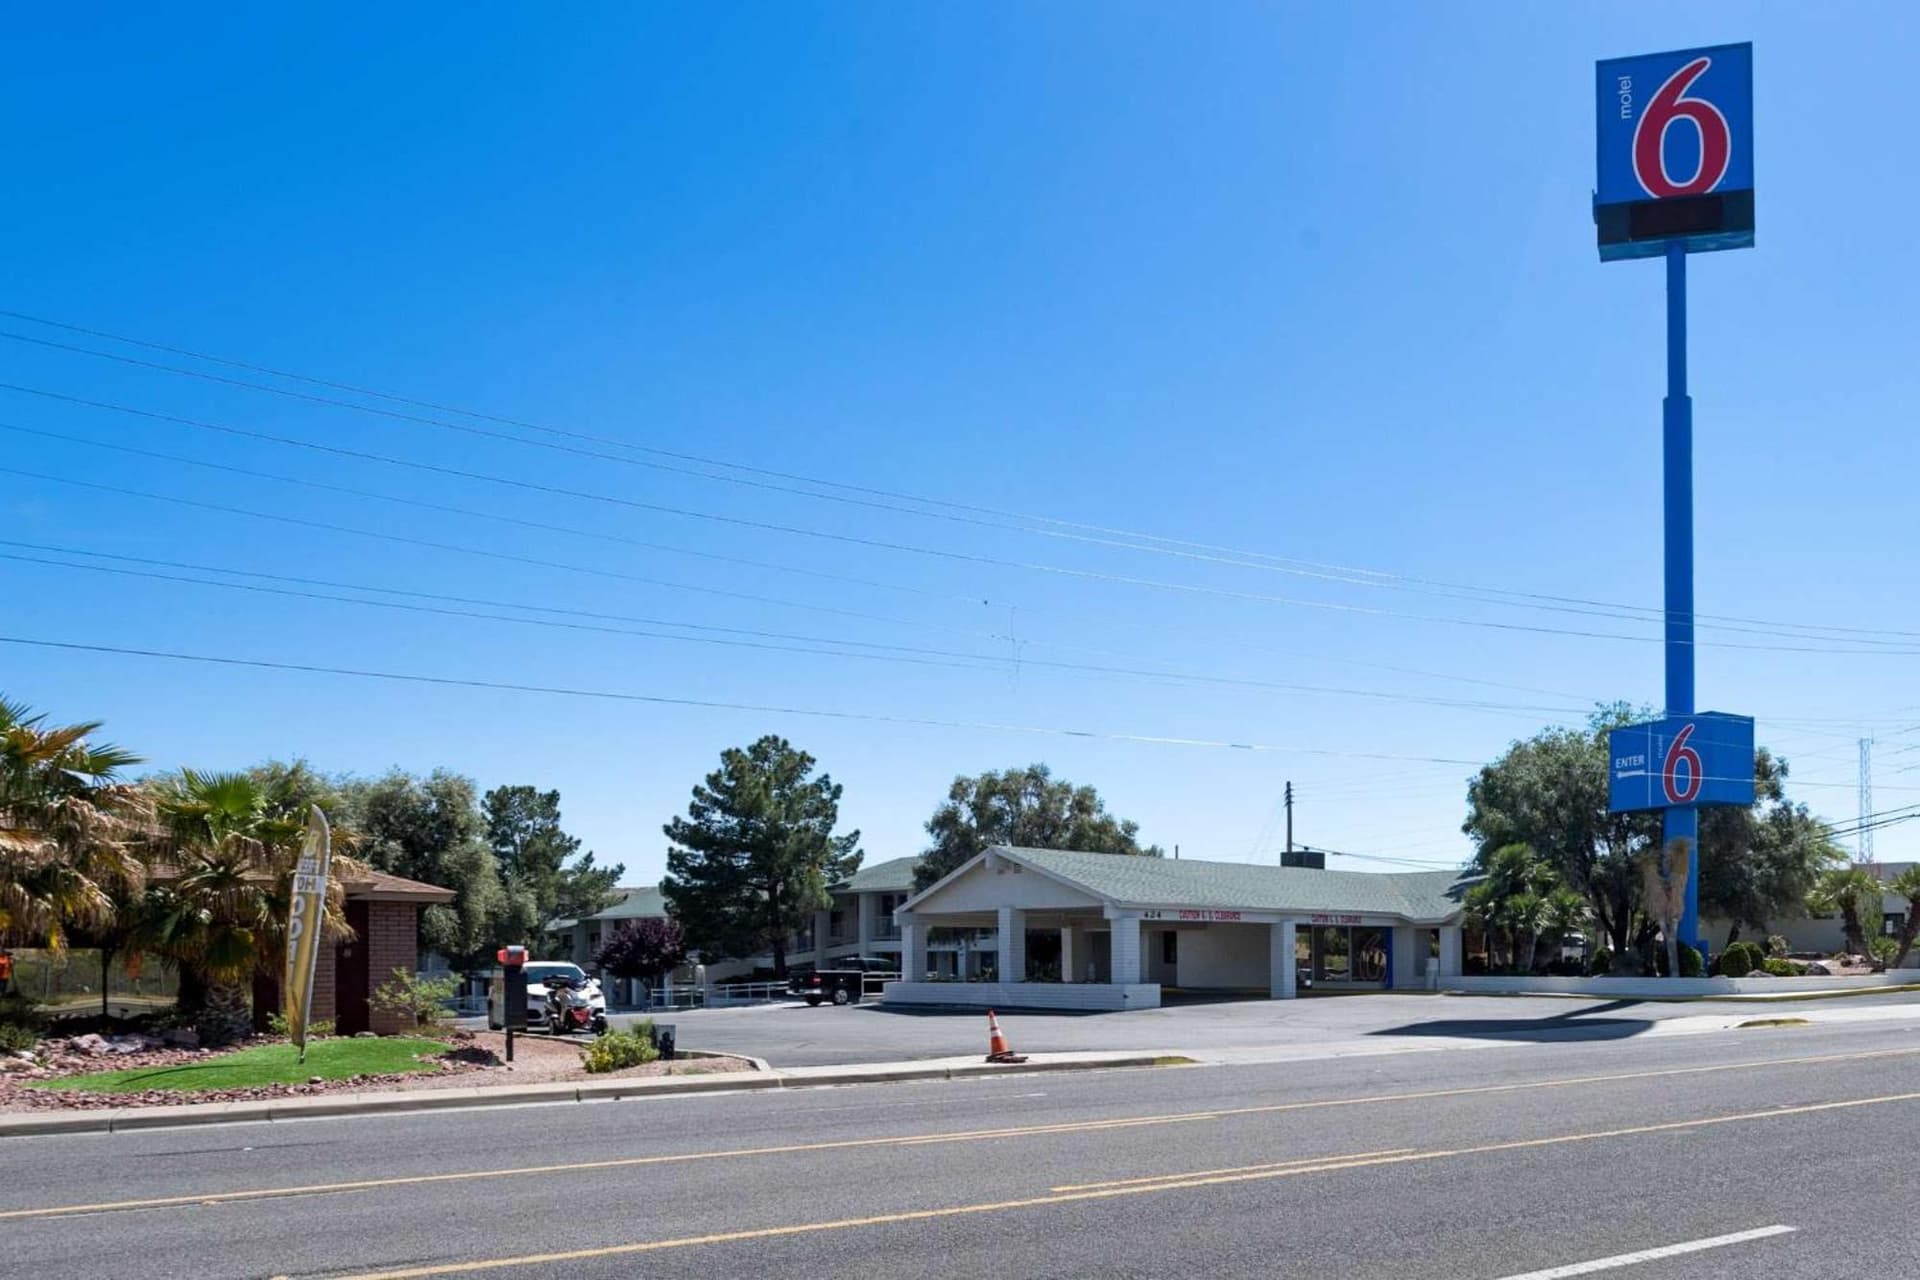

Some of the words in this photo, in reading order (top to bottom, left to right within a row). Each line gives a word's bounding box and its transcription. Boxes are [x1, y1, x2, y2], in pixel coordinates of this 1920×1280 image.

[1617, 75, 1632, 119] motel
[1632, 57, 1731, 199] 6
[1616, 755, 1645, 768] ENTER
[1662, 723, 1703, 804] 6
